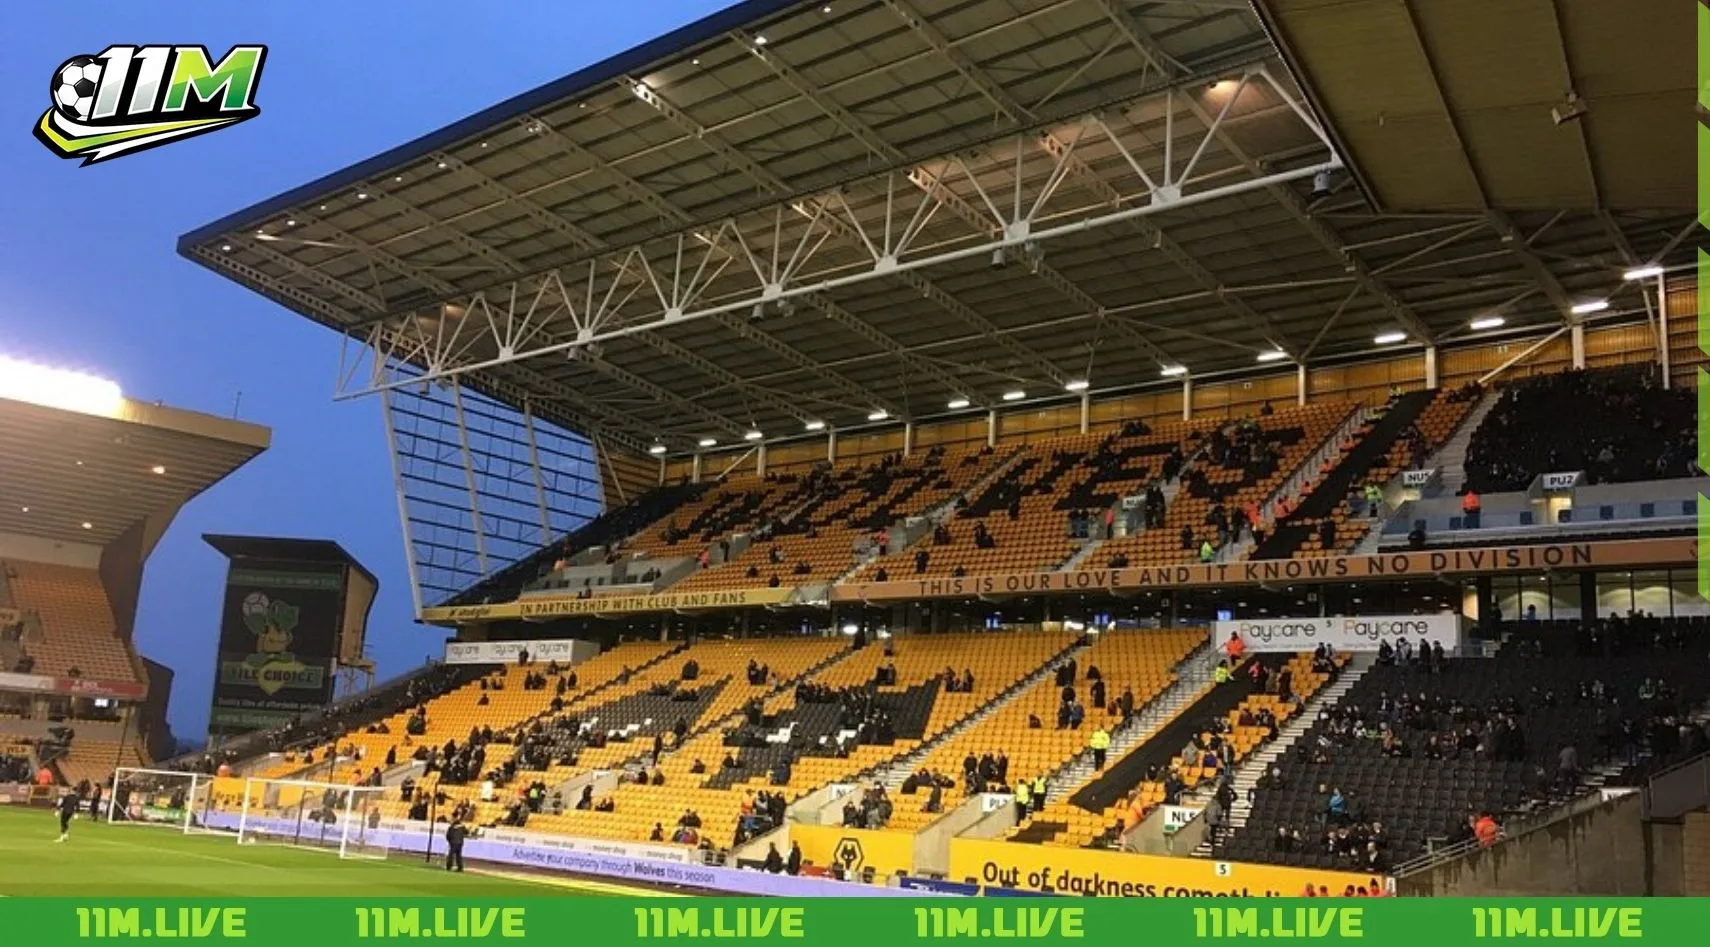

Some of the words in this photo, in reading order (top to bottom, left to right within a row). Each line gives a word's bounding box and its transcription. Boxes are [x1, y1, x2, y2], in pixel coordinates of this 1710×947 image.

[1550, 475, 1573, 485] PU2
[919, 580, 963, 596] THIS
[976, 577, 993, 593] IS
[1006, 573, 1050, 590] OUR
[1063, 570, 1121, 588] LOVE
[1139, 566, 1190, 585] AND
[1206, 564, 1229, 582] IT
[1245, 556, 1348, 580] KNOWS
[1367, 554, 1410, 574] NO
[1430, 545, 1592, 571] DIVISION
[536, 600, 609, 614] PARTNERSHIP
[613, 597, 642, 609] WITH
[647, 596, 678, 609] CLUB
[682, 593, 708, 606] AND
[714, 591, 746, 604] FANS
[1241, 622, 1316, 642] Paycare
[1343, 619, 1428, 640] Paycare
[564, 856, 599, 870] company
[601, 859, 632, 873] through
[633, 860, 665, 877] Wolves
[666, 865, 683, 879] this
[684, 870, 716, 883] season
[983, 861, 1020, 886] Out
[1028, 867, 1052, 889] of
[1056, 869, 1156, 897] darkness
[1219, 863, 1227, 875] 5
